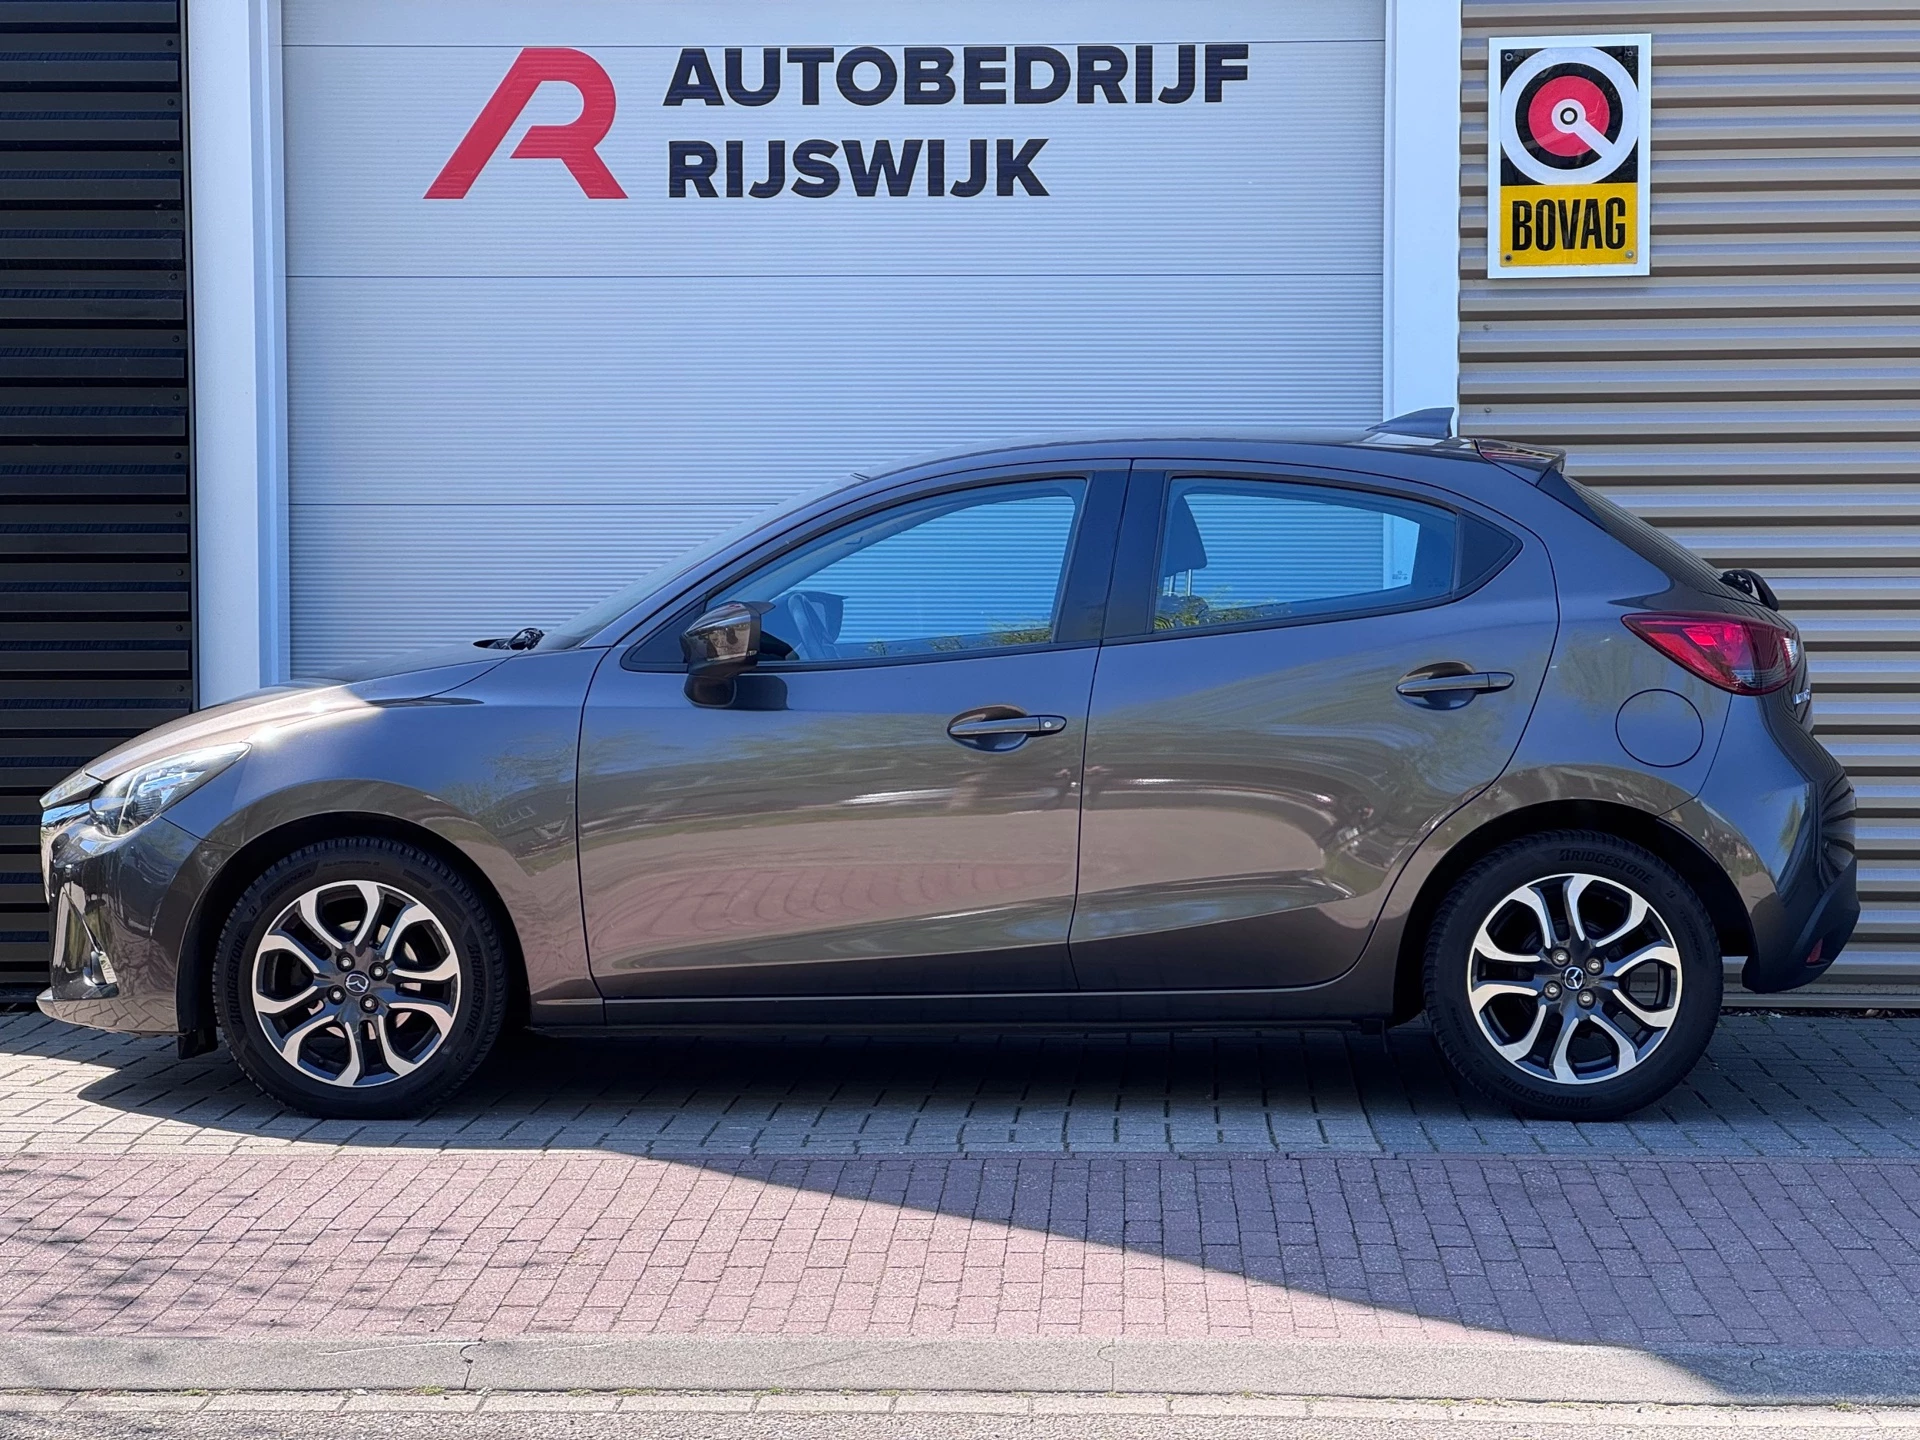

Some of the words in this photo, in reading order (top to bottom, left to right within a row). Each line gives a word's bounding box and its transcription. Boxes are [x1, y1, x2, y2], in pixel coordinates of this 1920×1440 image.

[662, 44, 1249, 107] AUTOBEDRIJF
[668, 138, 1050, 199] RIJSWIJK
[1511, 196, 1626, 252] BOVAG
[1559, 849, 1654, 883] BRIDGESTONE
[226, 931, 247, 1029] BRIDGESTONE
[465, 943, 485, 1038] BRIDGESTONE
